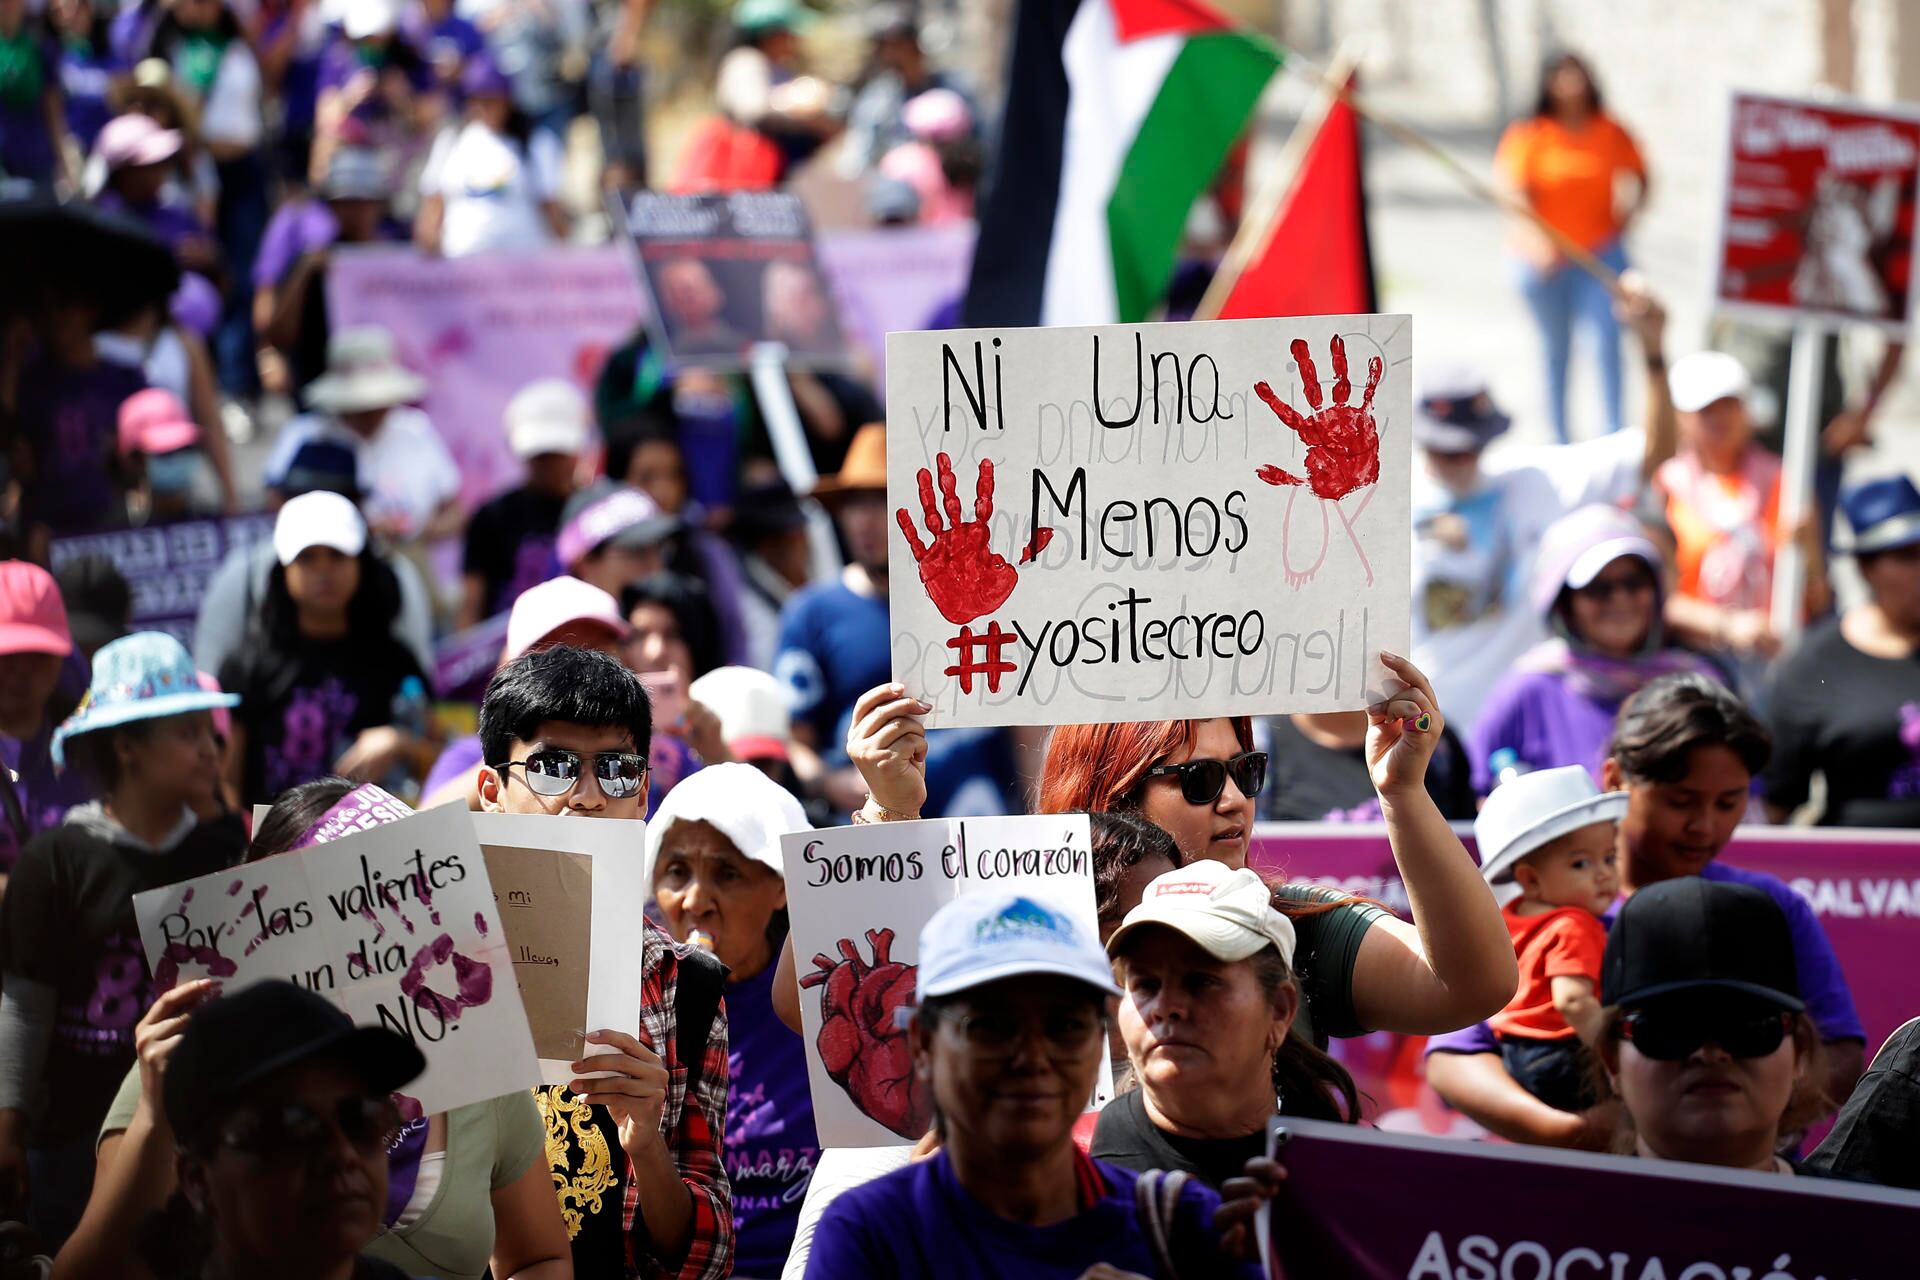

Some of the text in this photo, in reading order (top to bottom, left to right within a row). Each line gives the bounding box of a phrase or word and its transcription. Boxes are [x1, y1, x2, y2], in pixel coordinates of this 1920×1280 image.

[942, 331, 1234, 432] Ni Una
[1031, 467, 1249, 562] Menos
[944, 587, 1265, 696] #yositecreo
[159, 849, 466, 951] Por las valientes
[803, 821, 1088, 887] Somos el corazón
[1786, 877, 1920, 918] SALVA
[291, 933, 408, 993] un día
